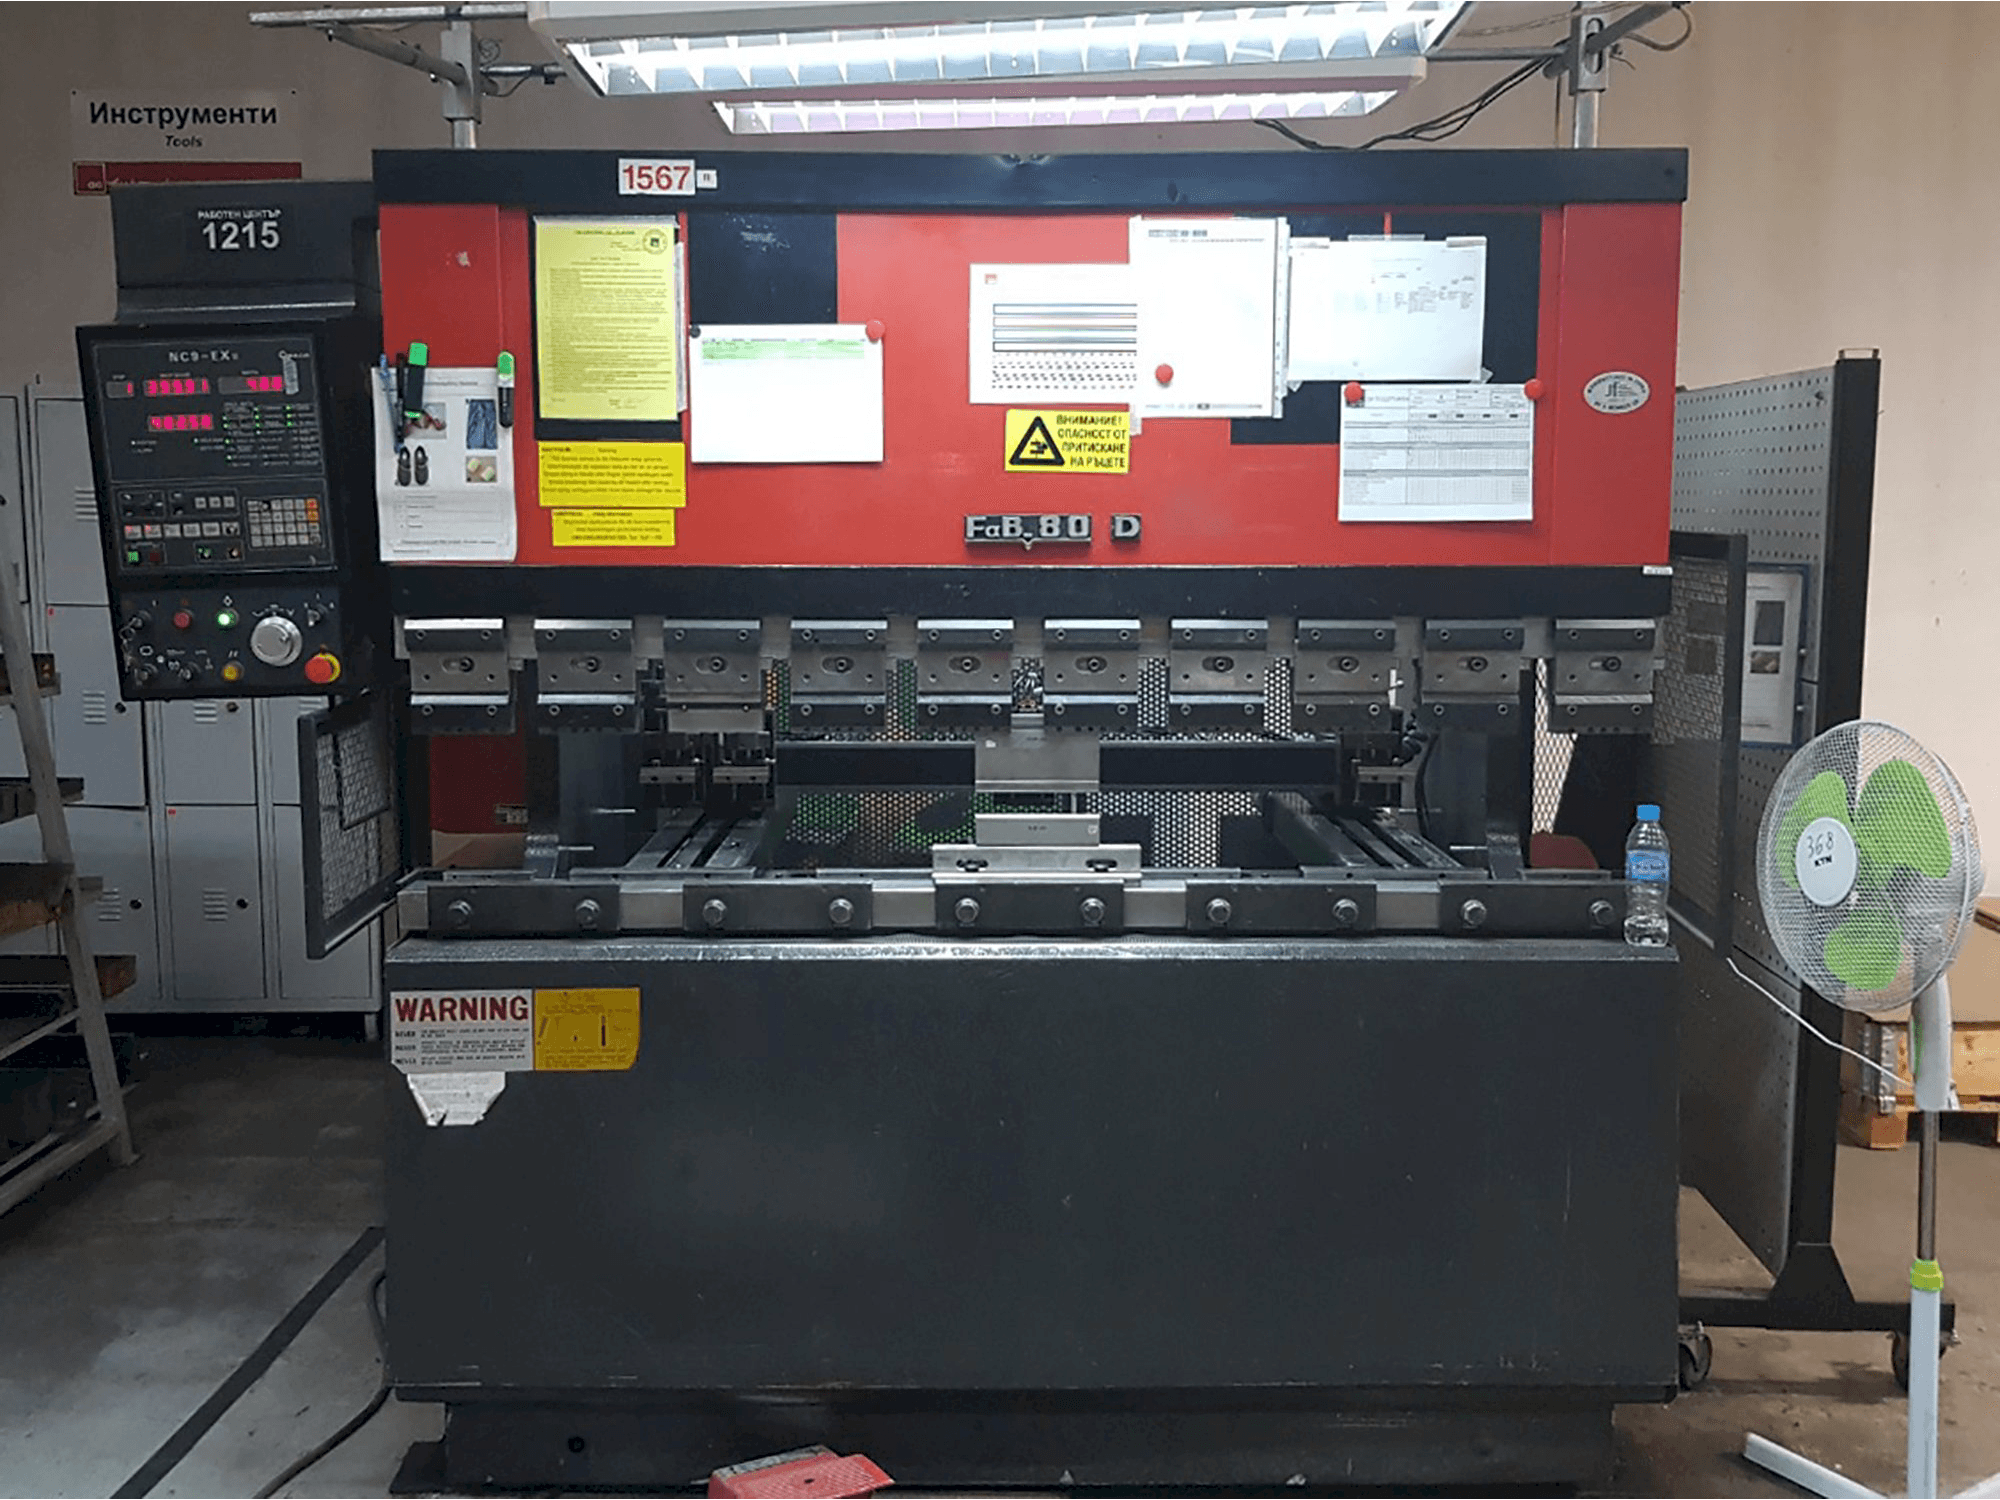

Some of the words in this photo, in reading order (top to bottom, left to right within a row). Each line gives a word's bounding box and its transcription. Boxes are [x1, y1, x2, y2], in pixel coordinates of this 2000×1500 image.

[89, 102, 278, 130] Инструменти
[165, 135, 203, 147] Tools
[622, 165, 691, 191] 1567
[203, 221, 280, 250] 1215
[1056, 413, 1122, 426] ВНИМАНИЕ!
[1114, 515, 1141, 538] D
[1806, 831, 1834, 859] 368
[395, 995, 529, 1022] WARNING
